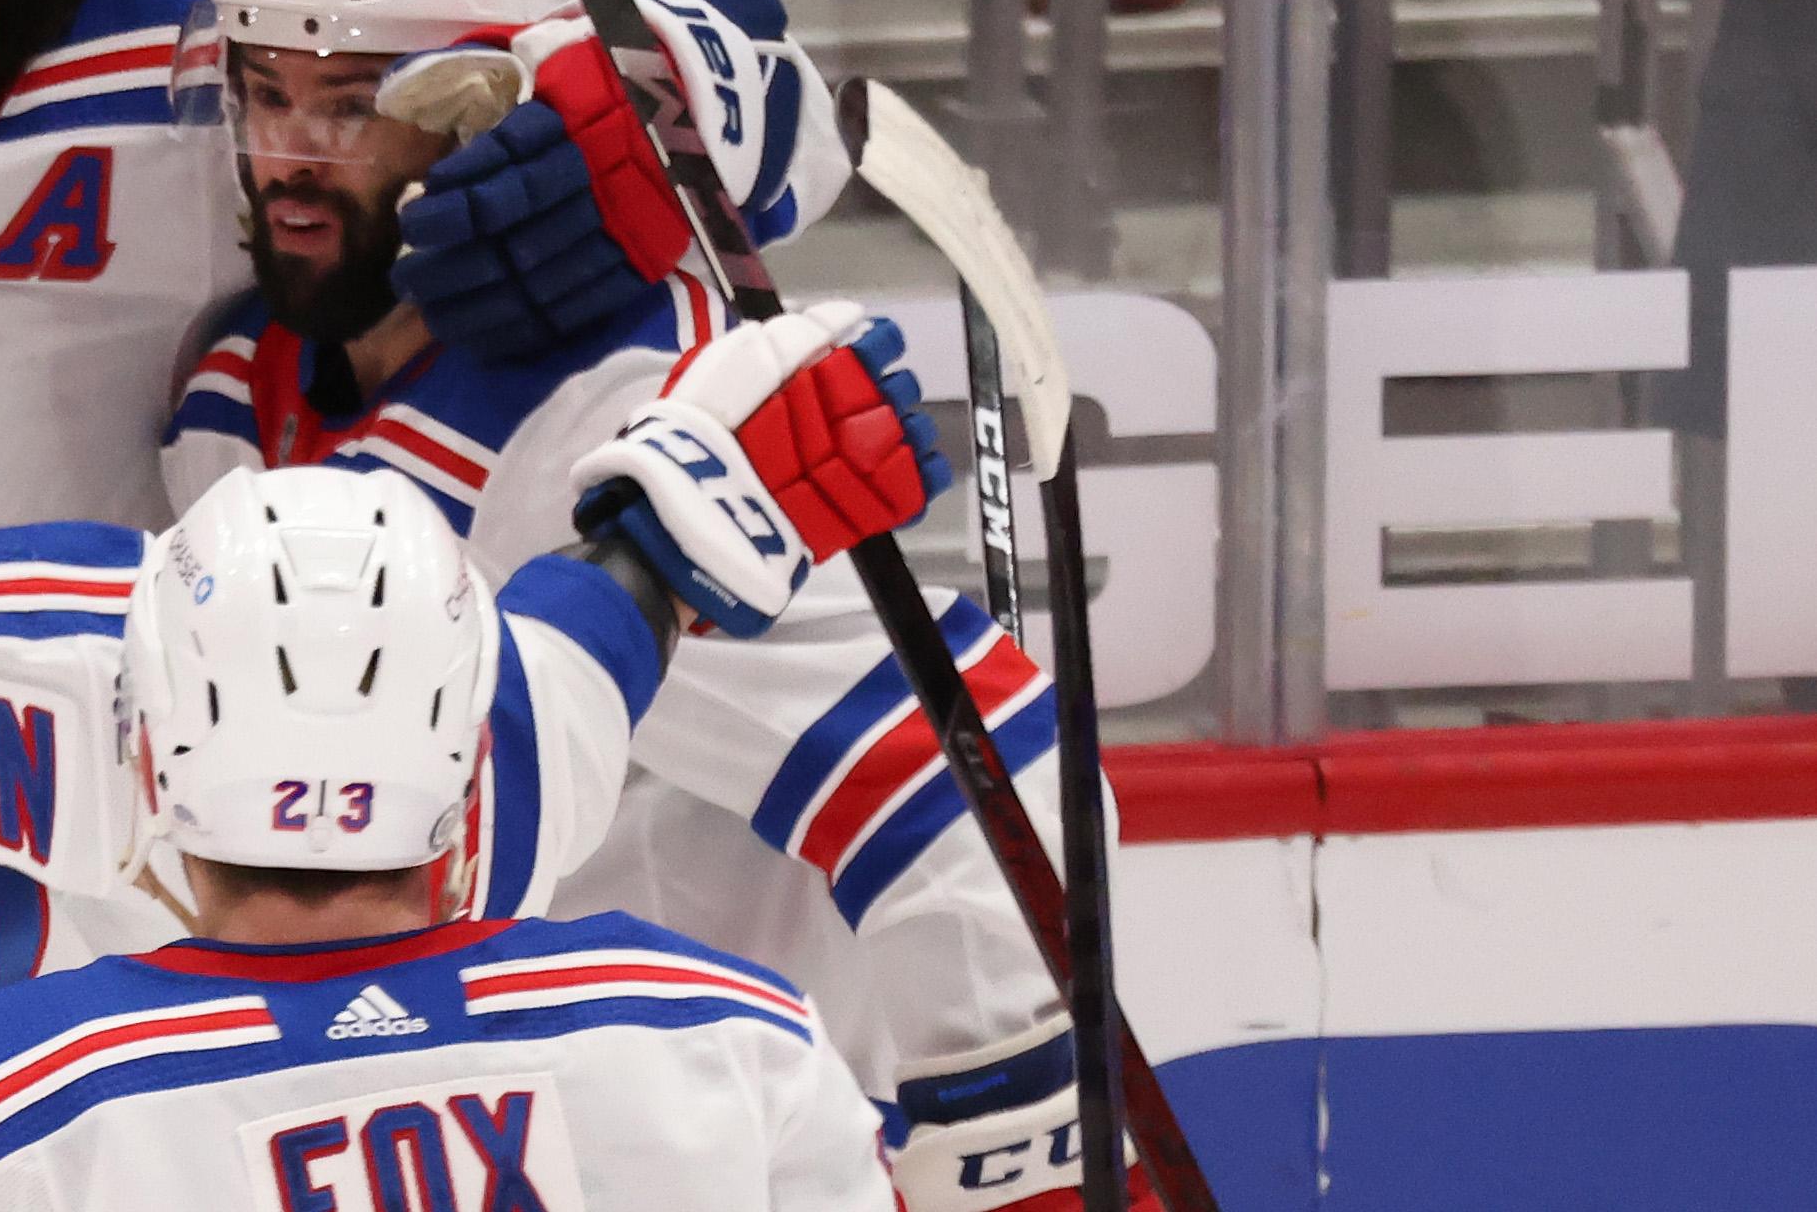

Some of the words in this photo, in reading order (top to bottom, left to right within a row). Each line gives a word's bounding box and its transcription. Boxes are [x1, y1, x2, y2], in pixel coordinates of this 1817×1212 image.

[975, 405, 1012, 556] CCM
[272, 781, 375, 833] 23
[326, 1017, 429, 1041] adidas
[269, 1090, 535, 1212] FOX
